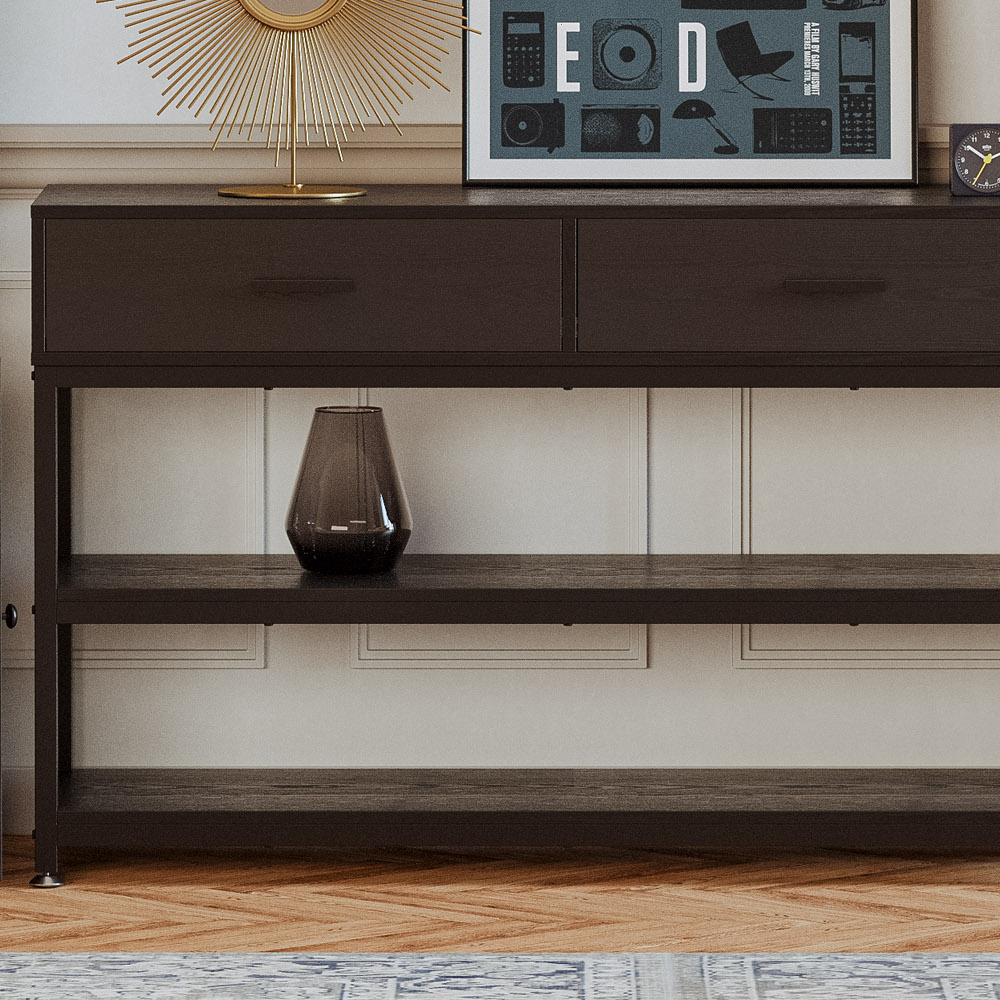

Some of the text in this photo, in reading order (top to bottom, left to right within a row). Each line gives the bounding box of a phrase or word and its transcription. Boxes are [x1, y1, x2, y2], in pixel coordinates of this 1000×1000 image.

[811, 28, 819, 43] FILM
[811, 44, 819, 52] BY
[811, 54, 819, 70] GARY
[803, 69, 811, 83] 13TH,
[811, 71, 820, 96] HUSWIT
